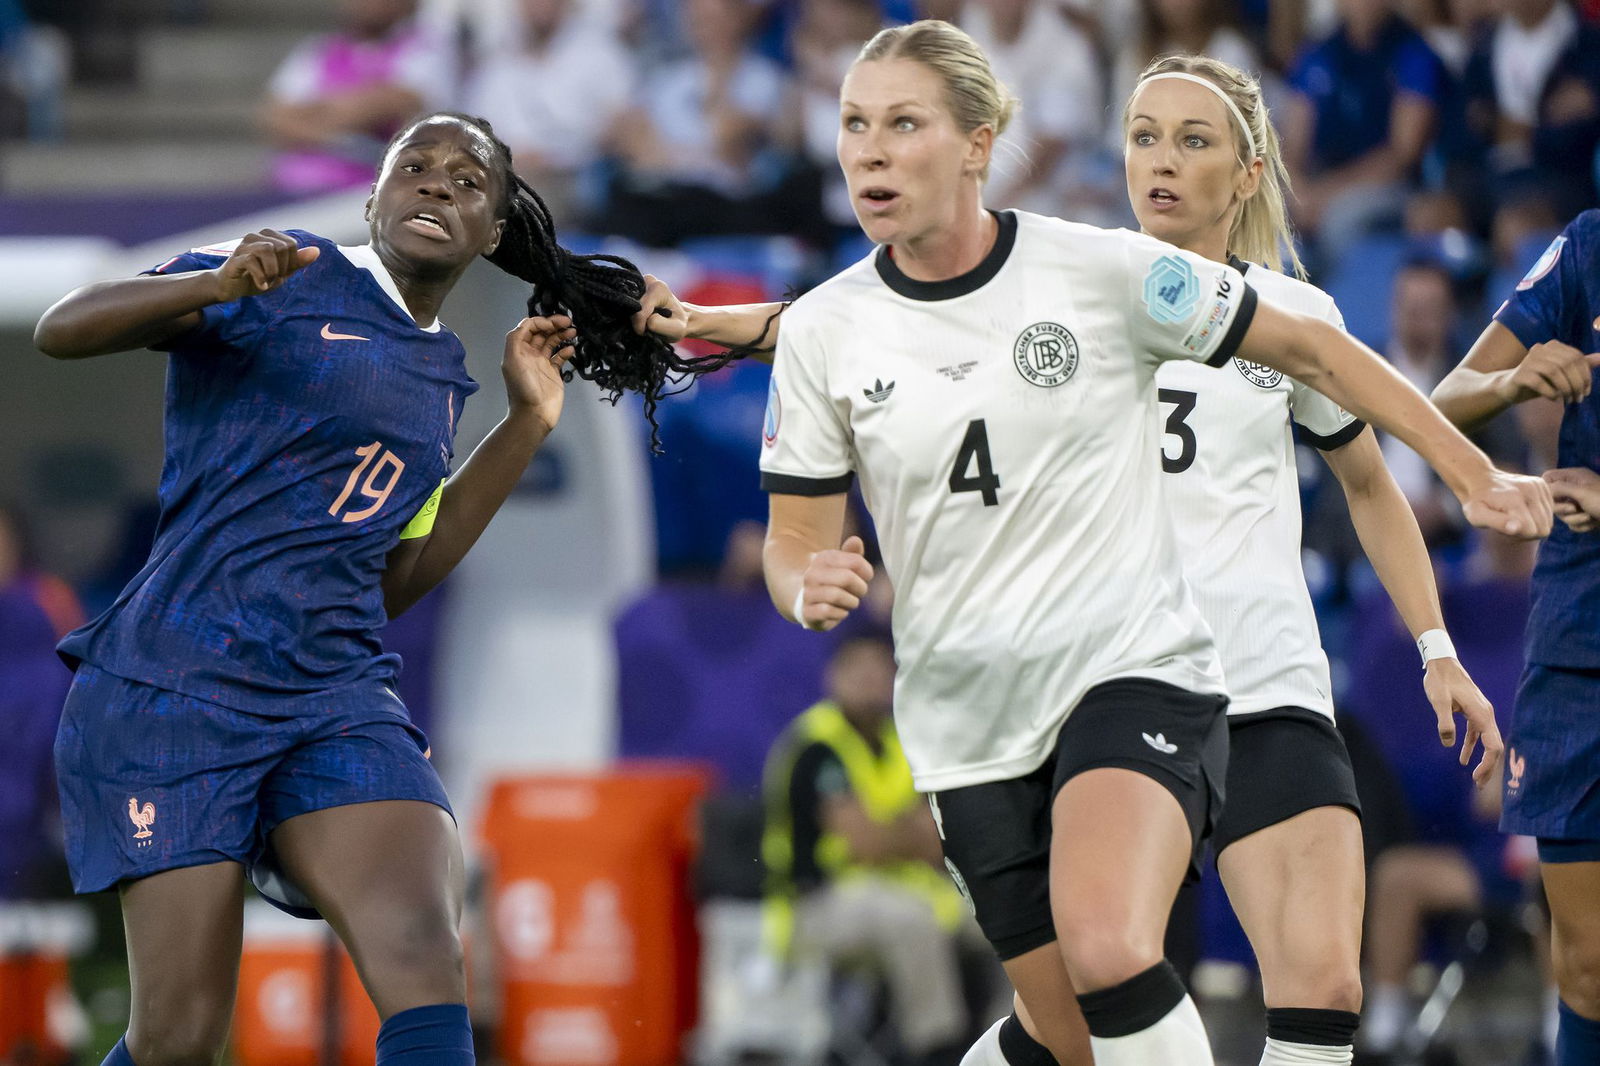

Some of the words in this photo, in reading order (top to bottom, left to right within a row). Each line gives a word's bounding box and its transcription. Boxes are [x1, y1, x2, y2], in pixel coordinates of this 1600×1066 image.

[1018, 332, 1038, 381] DEUTSCHER
[1254, 377, 1266, 386] 125
[949, 418, 1001, 507] 4
[1158, 388, 1198, 474] 3
[328, 440, 406, 523] 19
